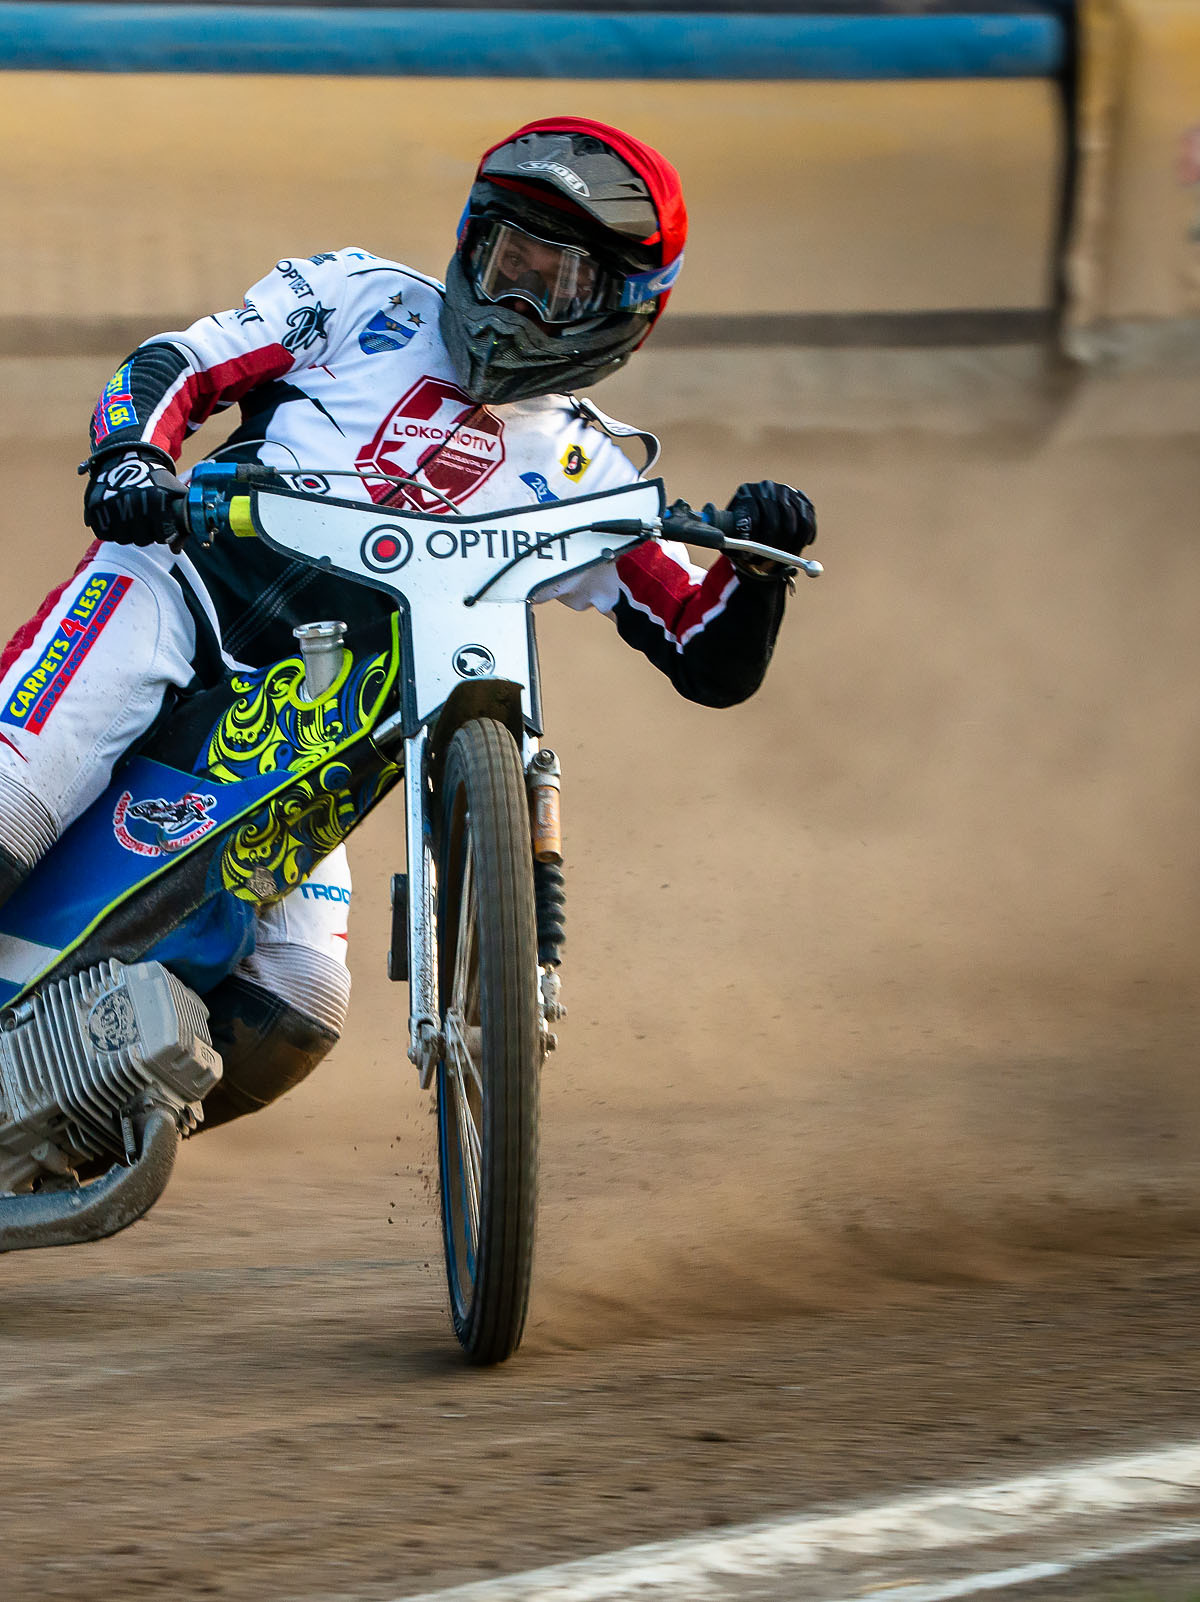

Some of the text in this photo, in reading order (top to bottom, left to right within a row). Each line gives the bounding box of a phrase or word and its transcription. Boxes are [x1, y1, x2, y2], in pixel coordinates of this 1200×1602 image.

[526, 162, 585, 190] SHOEI
[276, 260, 314, 299] OPTET
[393, 422, 496, 452] LOKOMOTIV
[426, 529, 571, 561] OPTIBET
[9, 577, 108, 718] CARPETS 4 LESS
[34, 677, 66, 724] CARPET
[96, 581, 126, 624] OUTLET
